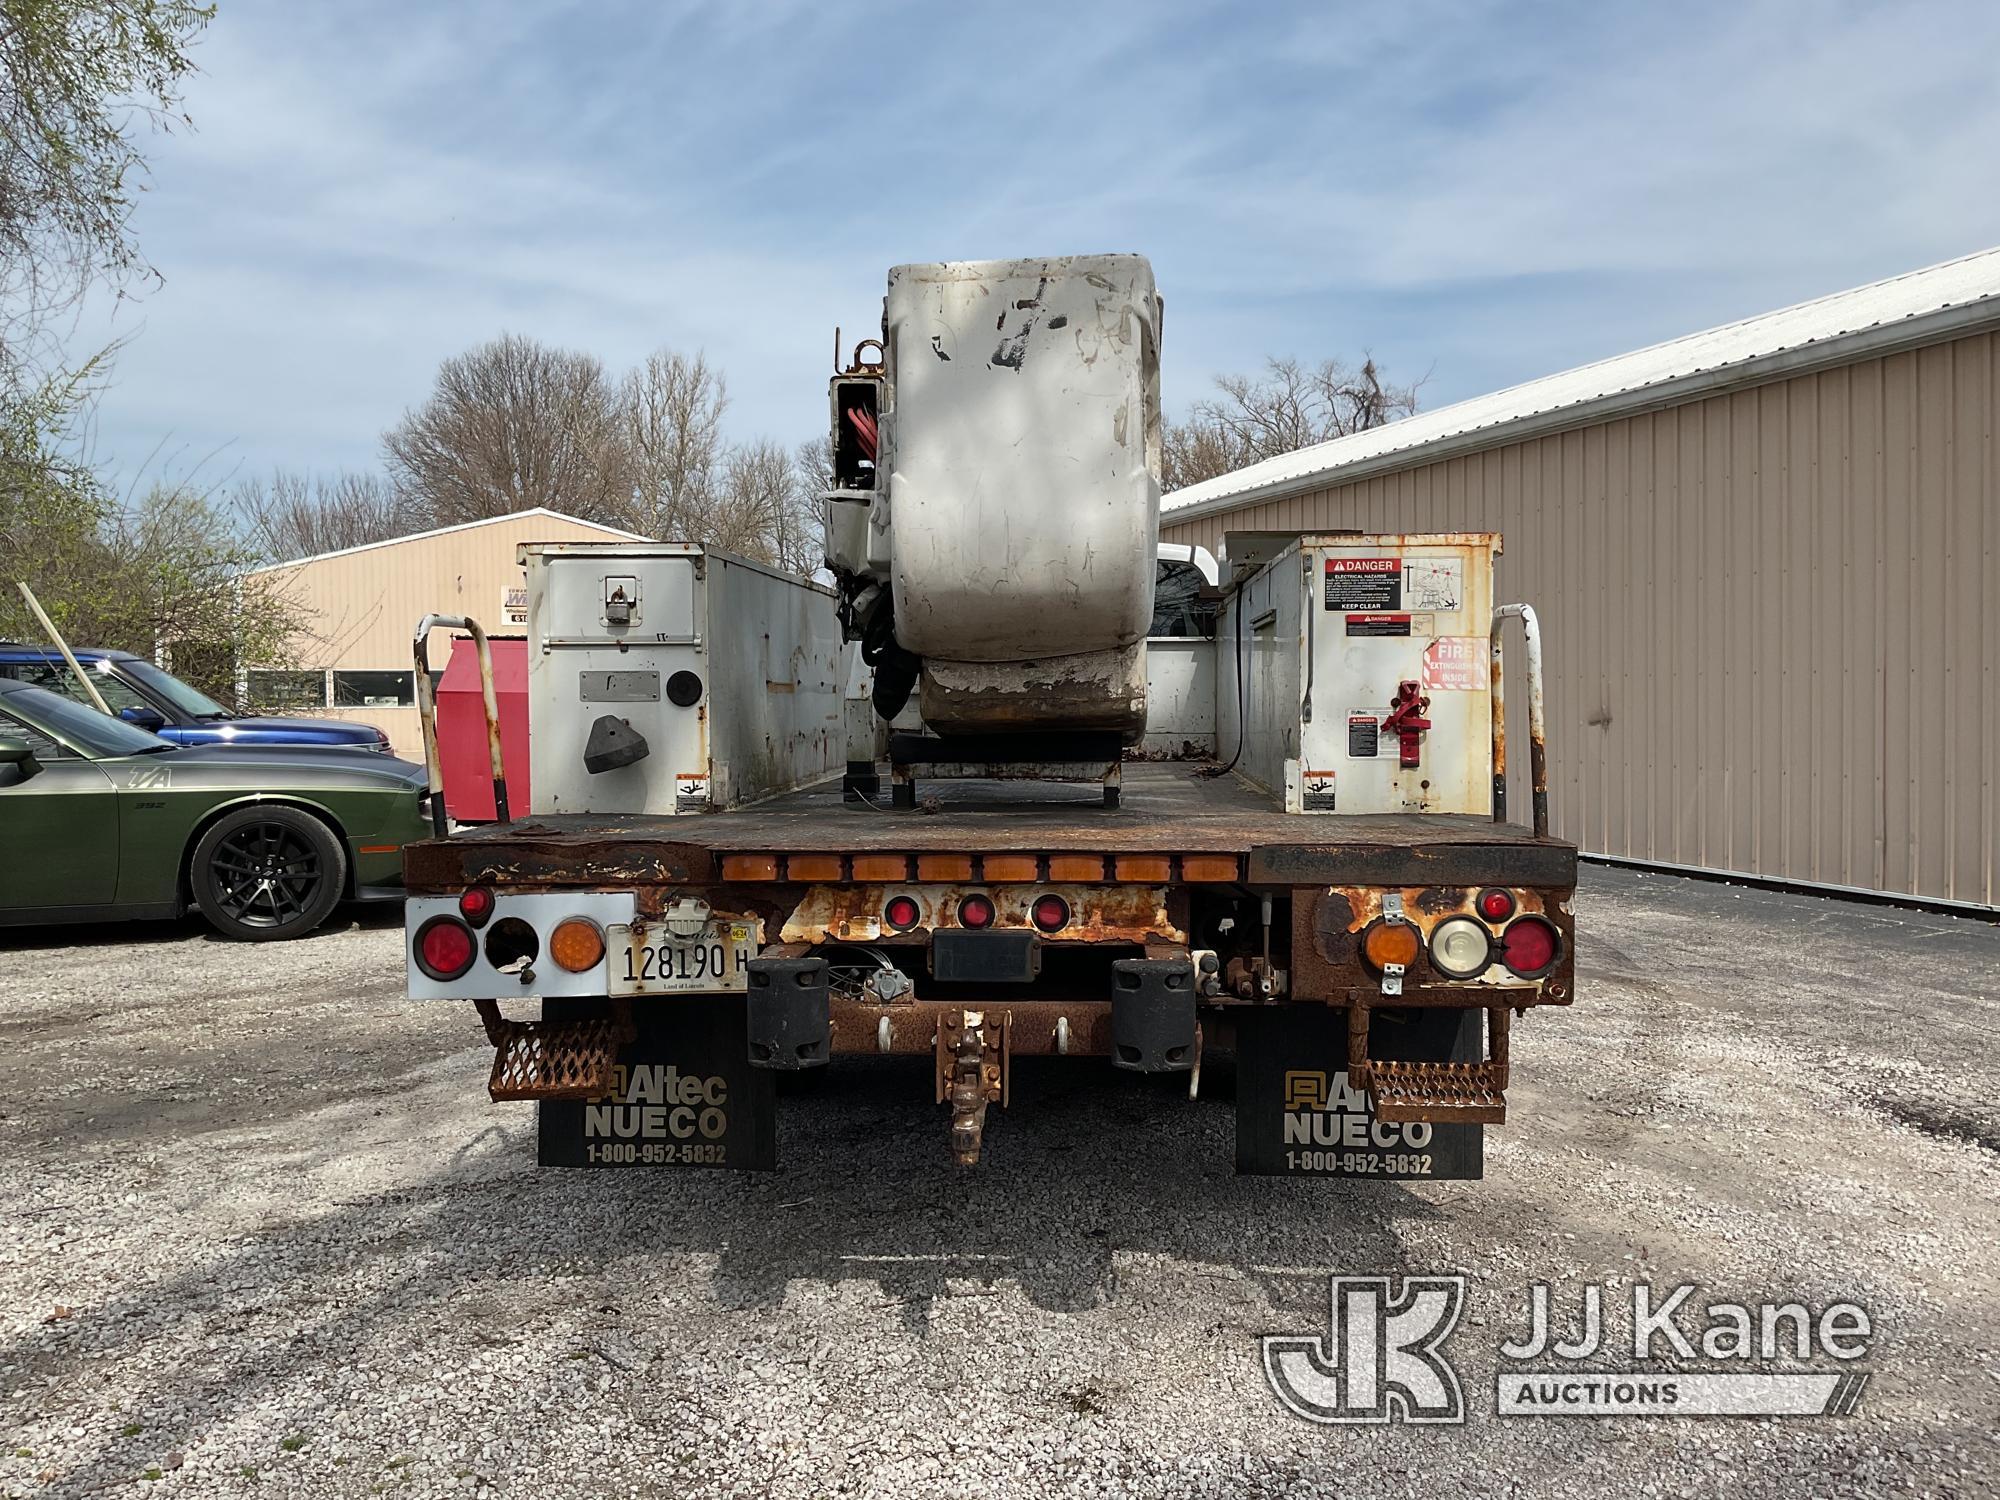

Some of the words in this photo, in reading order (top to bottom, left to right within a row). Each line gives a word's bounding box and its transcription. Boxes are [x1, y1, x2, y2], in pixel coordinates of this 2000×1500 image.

[1346, 561, 1393, 571] DANGER
[1438, 644, 1473, 659] FIRE
[1442, 672, 1472, 682] INSIDE
[623, 944, 725, 982] 128190
[735, 949, 748, 972] H
[625, 1065, 728, 1106] Altec
[585, 1106, 727, 1139] NUECO
[1284, 1112, 1433, 1149] NUECO
[586, 1143, 726, 1164] 1-800-952-5832
[1286, 1150, 1432, 1174] 1-800-952-5832
